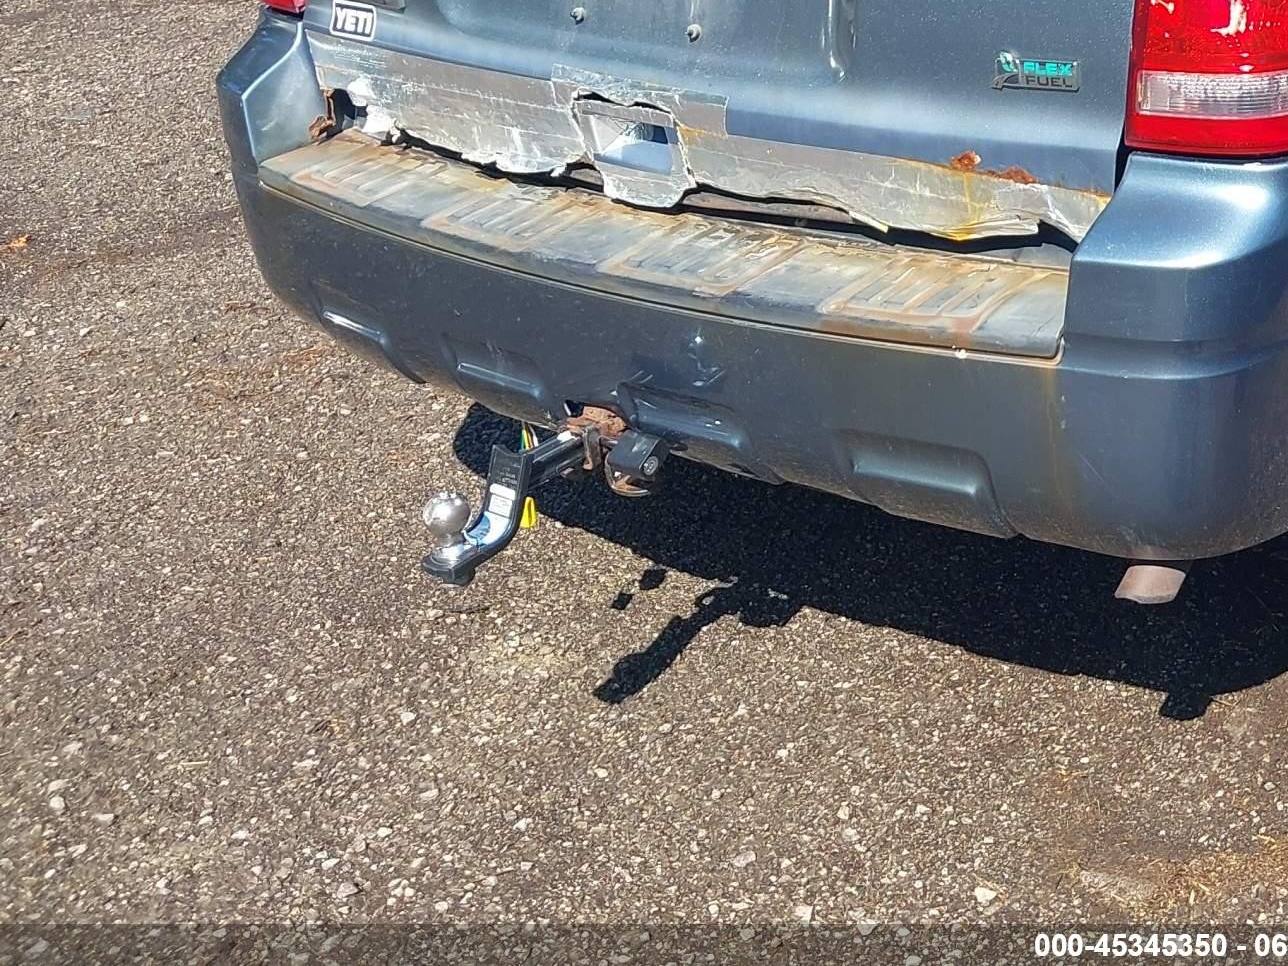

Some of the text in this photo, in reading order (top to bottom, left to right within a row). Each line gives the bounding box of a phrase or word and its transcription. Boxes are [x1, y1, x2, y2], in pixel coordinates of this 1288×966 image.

[335, 6, 373, 34] YETI
[1023, 61, 1073, 76] FLEX
[1026, 75, 1073, 88] FUEL
